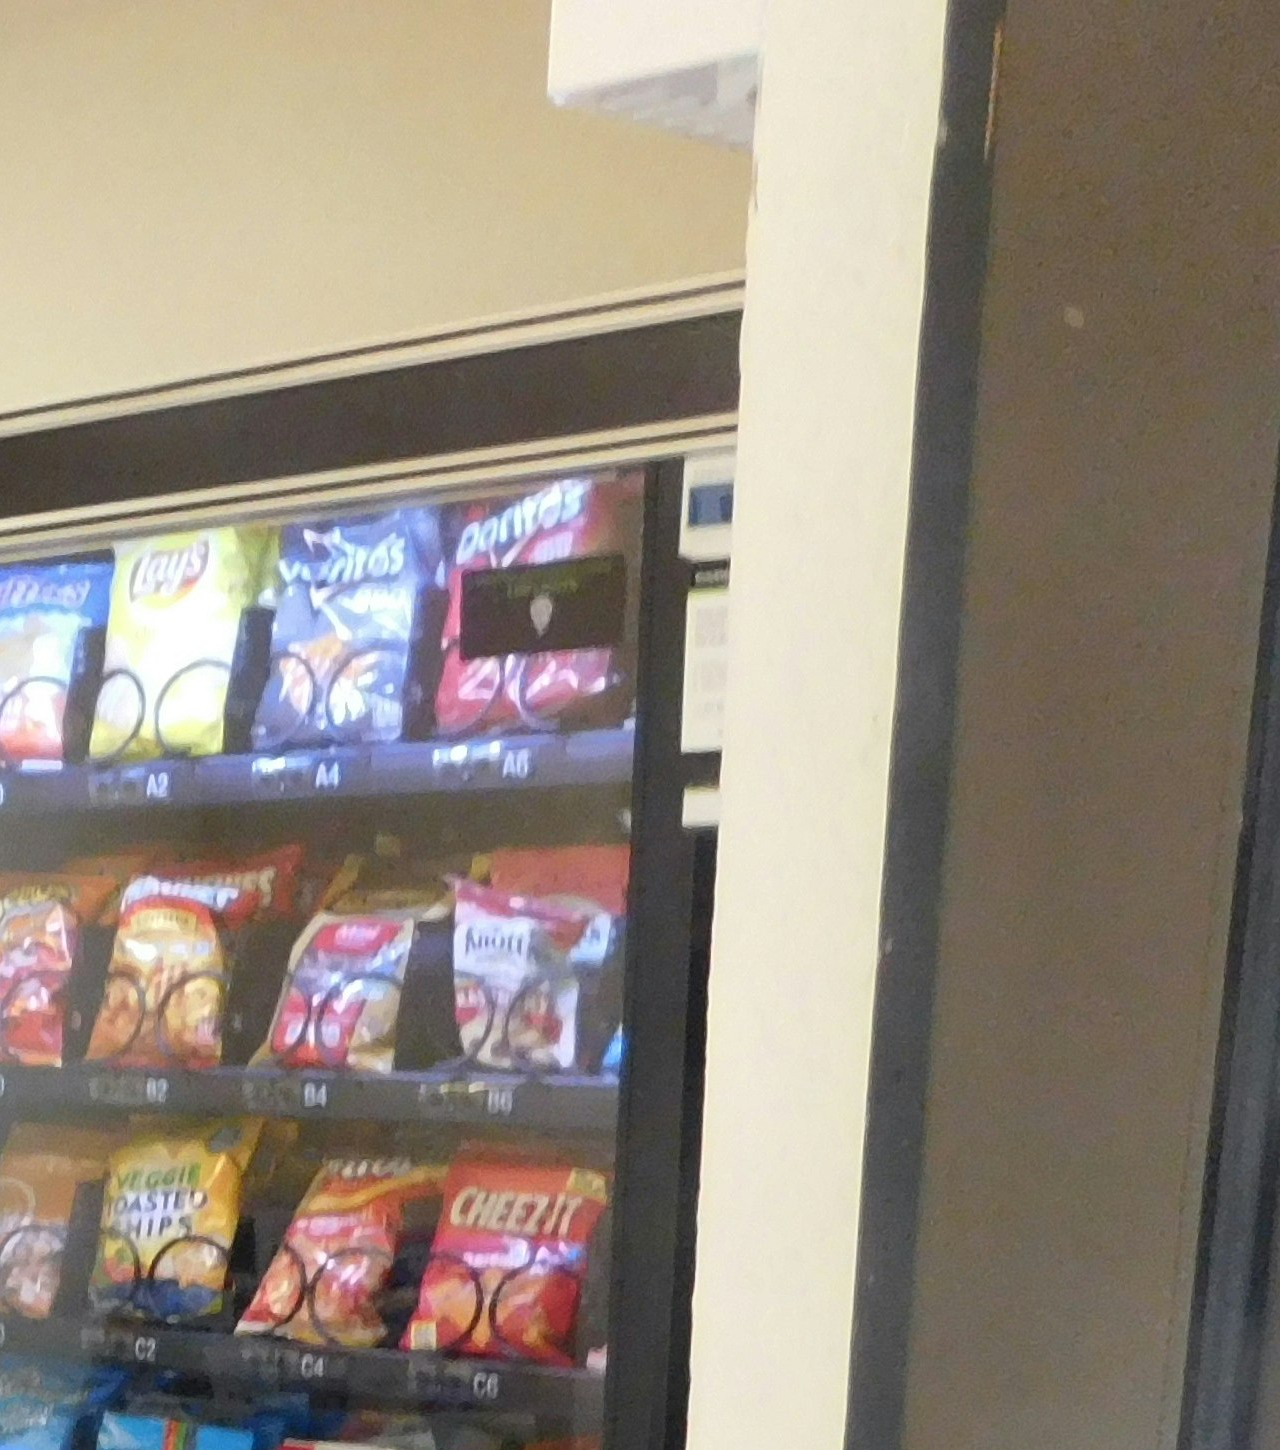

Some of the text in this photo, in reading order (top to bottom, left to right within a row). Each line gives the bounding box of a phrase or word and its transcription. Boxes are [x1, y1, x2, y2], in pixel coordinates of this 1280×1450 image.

[456, 478, 592, 564] Doritos
[146, 772, 171, 799] A2
[118, 1162, 202, 1191] VEGGIE
[135, 1337, 156, 1363] C2
[301, 1353, 325, 1378] C4
